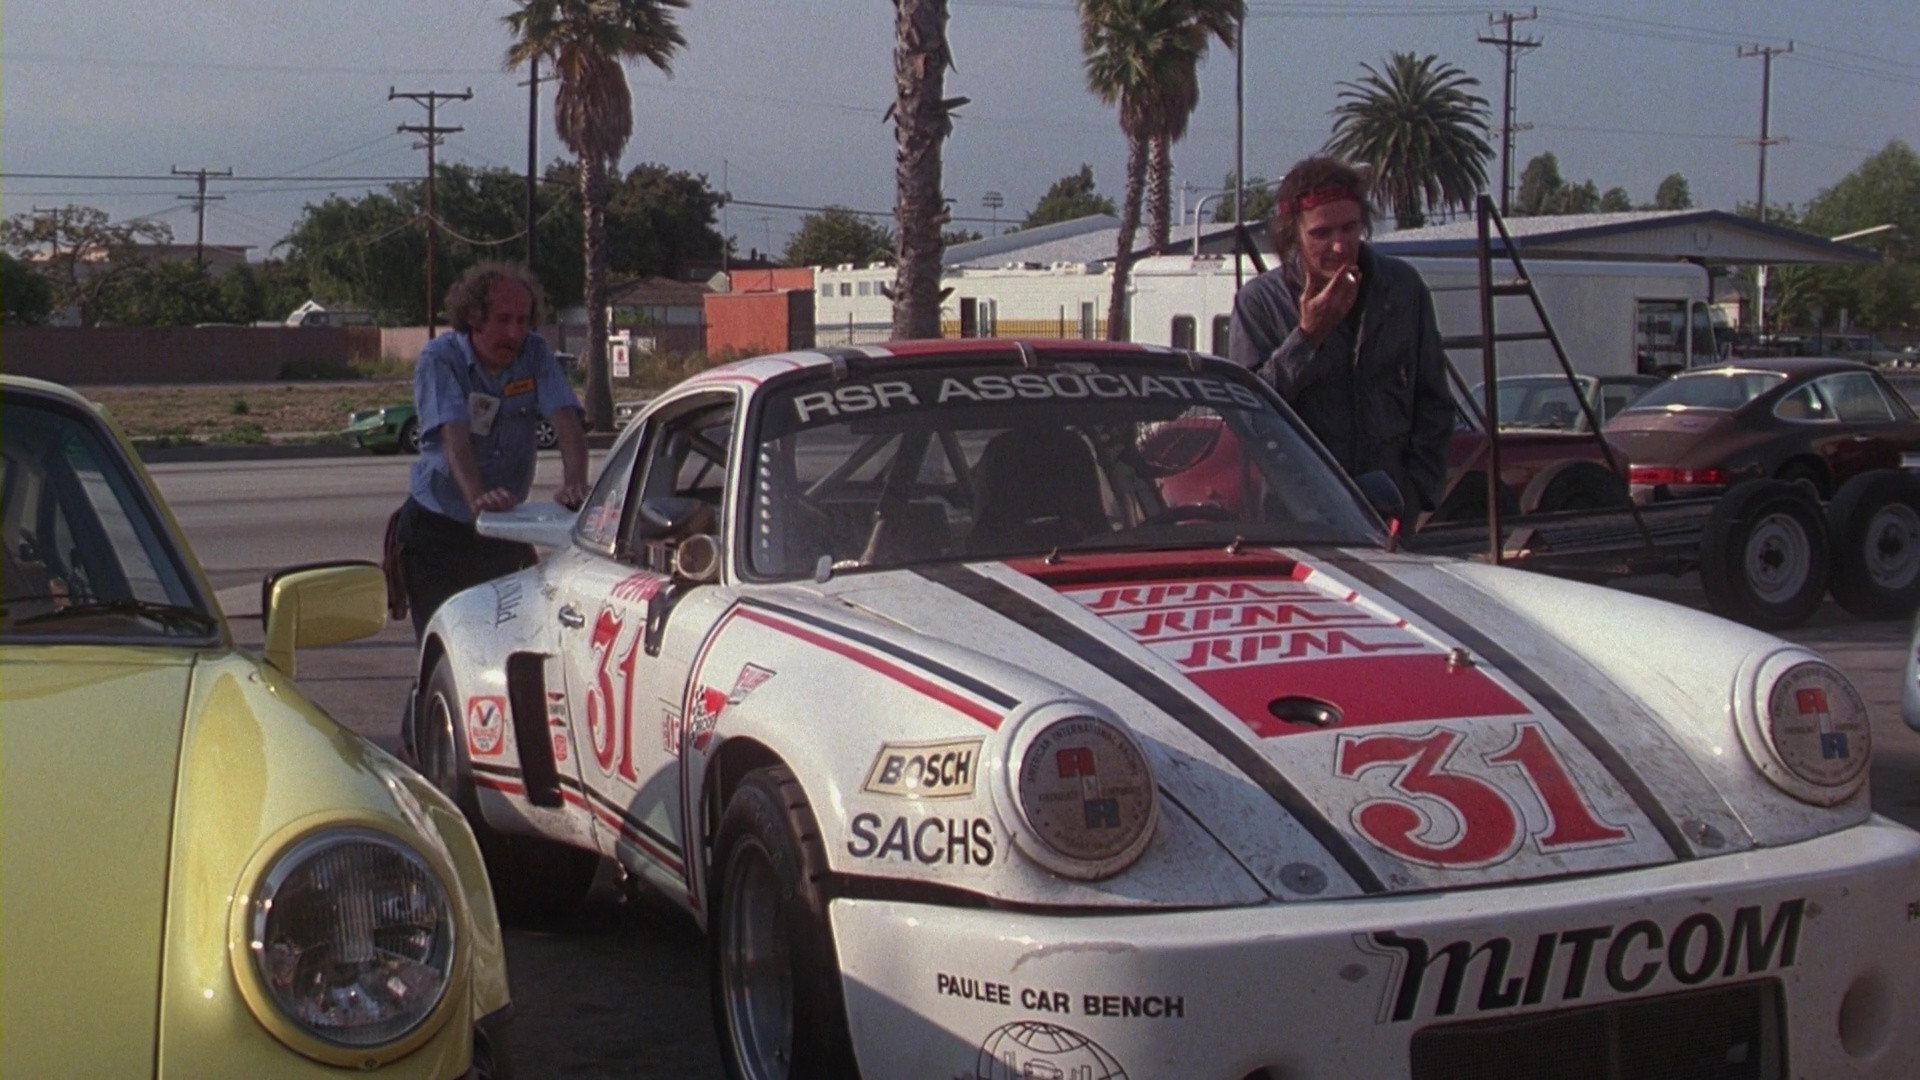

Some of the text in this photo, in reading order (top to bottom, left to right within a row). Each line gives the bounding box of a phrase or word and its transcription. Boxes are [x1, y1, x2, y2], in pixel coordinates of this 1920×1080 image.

[793, 373, 1261, 423] RSR ASSOCIATES
[1086, 581, 1322, 609] RPM
[1130, 603, 1371, 636] RPM
[1176, 630, 1424, 668] RPM
[586, 606, 641, 785] 31
[878, 750, 973, 788] BOSCH
[1333, 720, 1636, 870] 31
[847, 812, 994, 866] SACHS
[937, 973, 1185, 1018] PAULEE CAR BENCH
